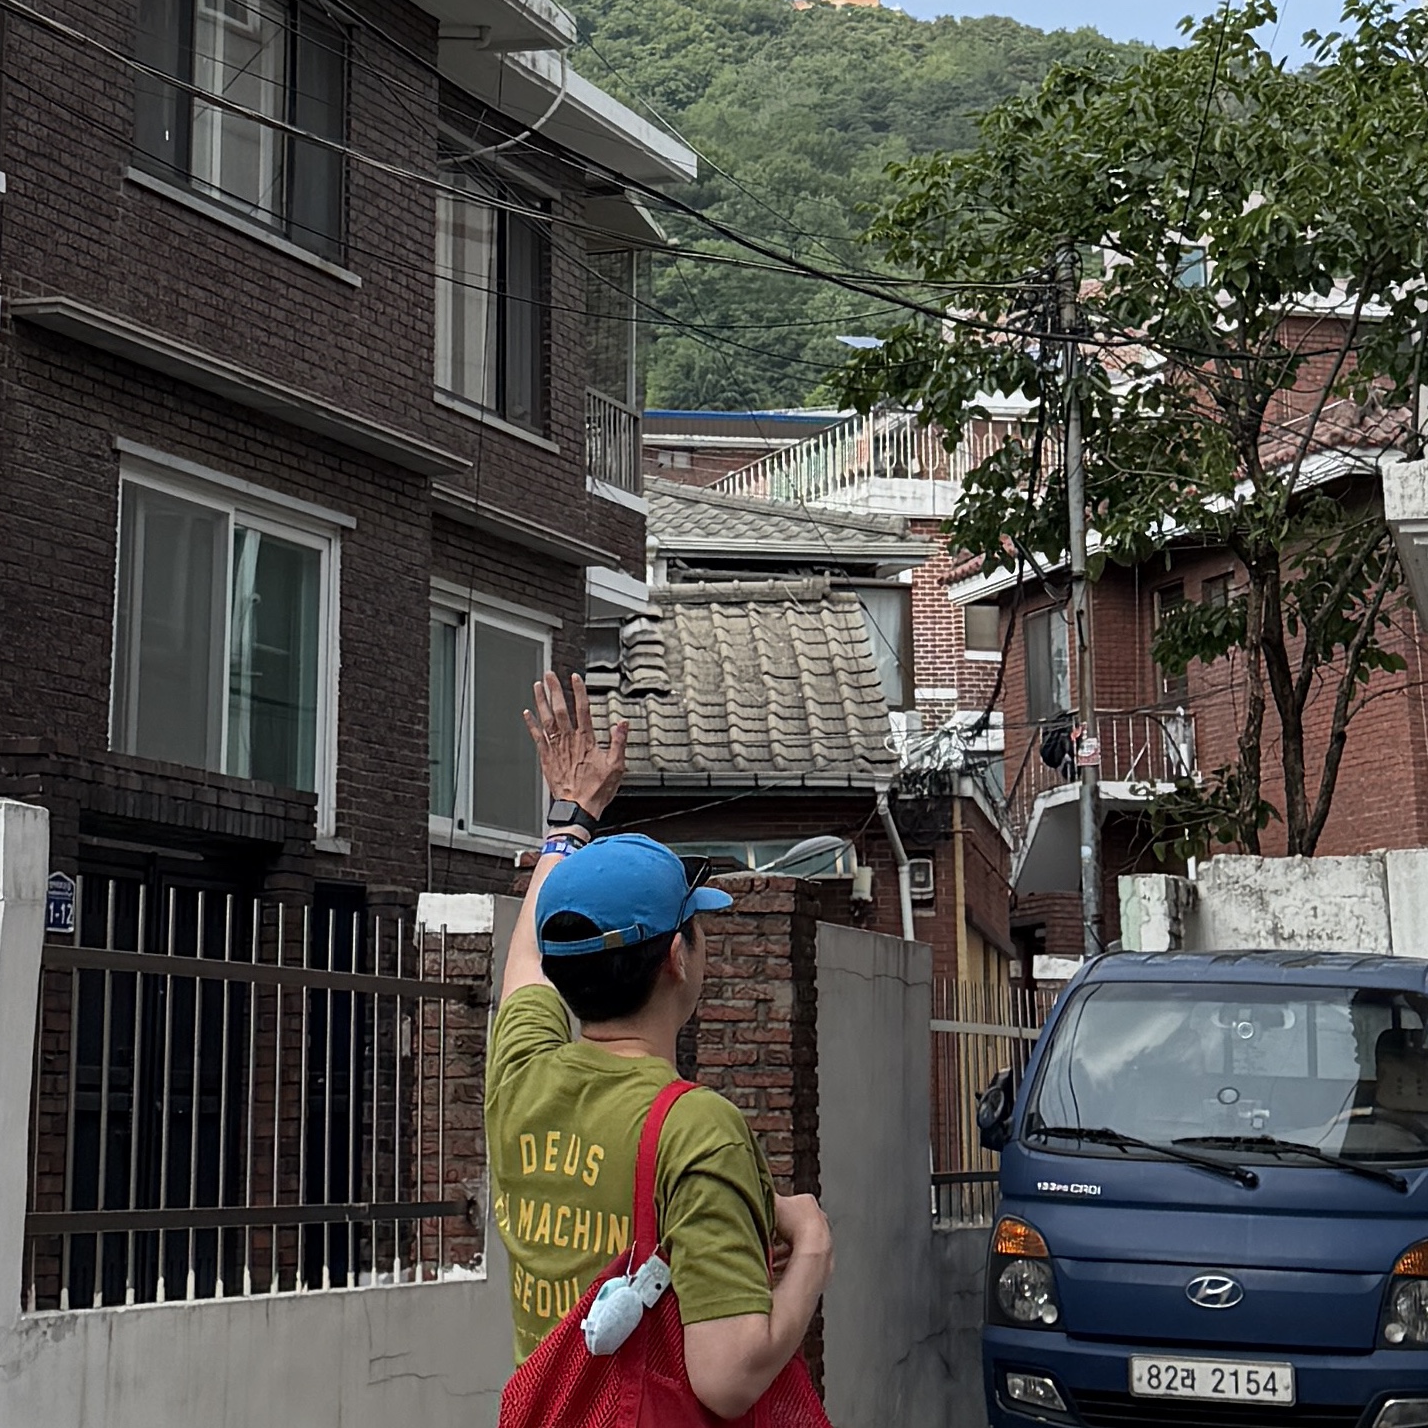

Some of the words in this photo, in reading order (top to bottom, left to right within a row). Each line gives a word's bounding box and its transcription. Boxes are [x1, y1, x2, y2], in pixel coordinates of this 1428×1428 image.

[520, 1131, 605, 1187] DEUS
[517, 1197, 629, 1256] MACHIN
[1147, 1364, 1196, 1391] 82라
[1211, 1368, 1278, 1396] 2154
